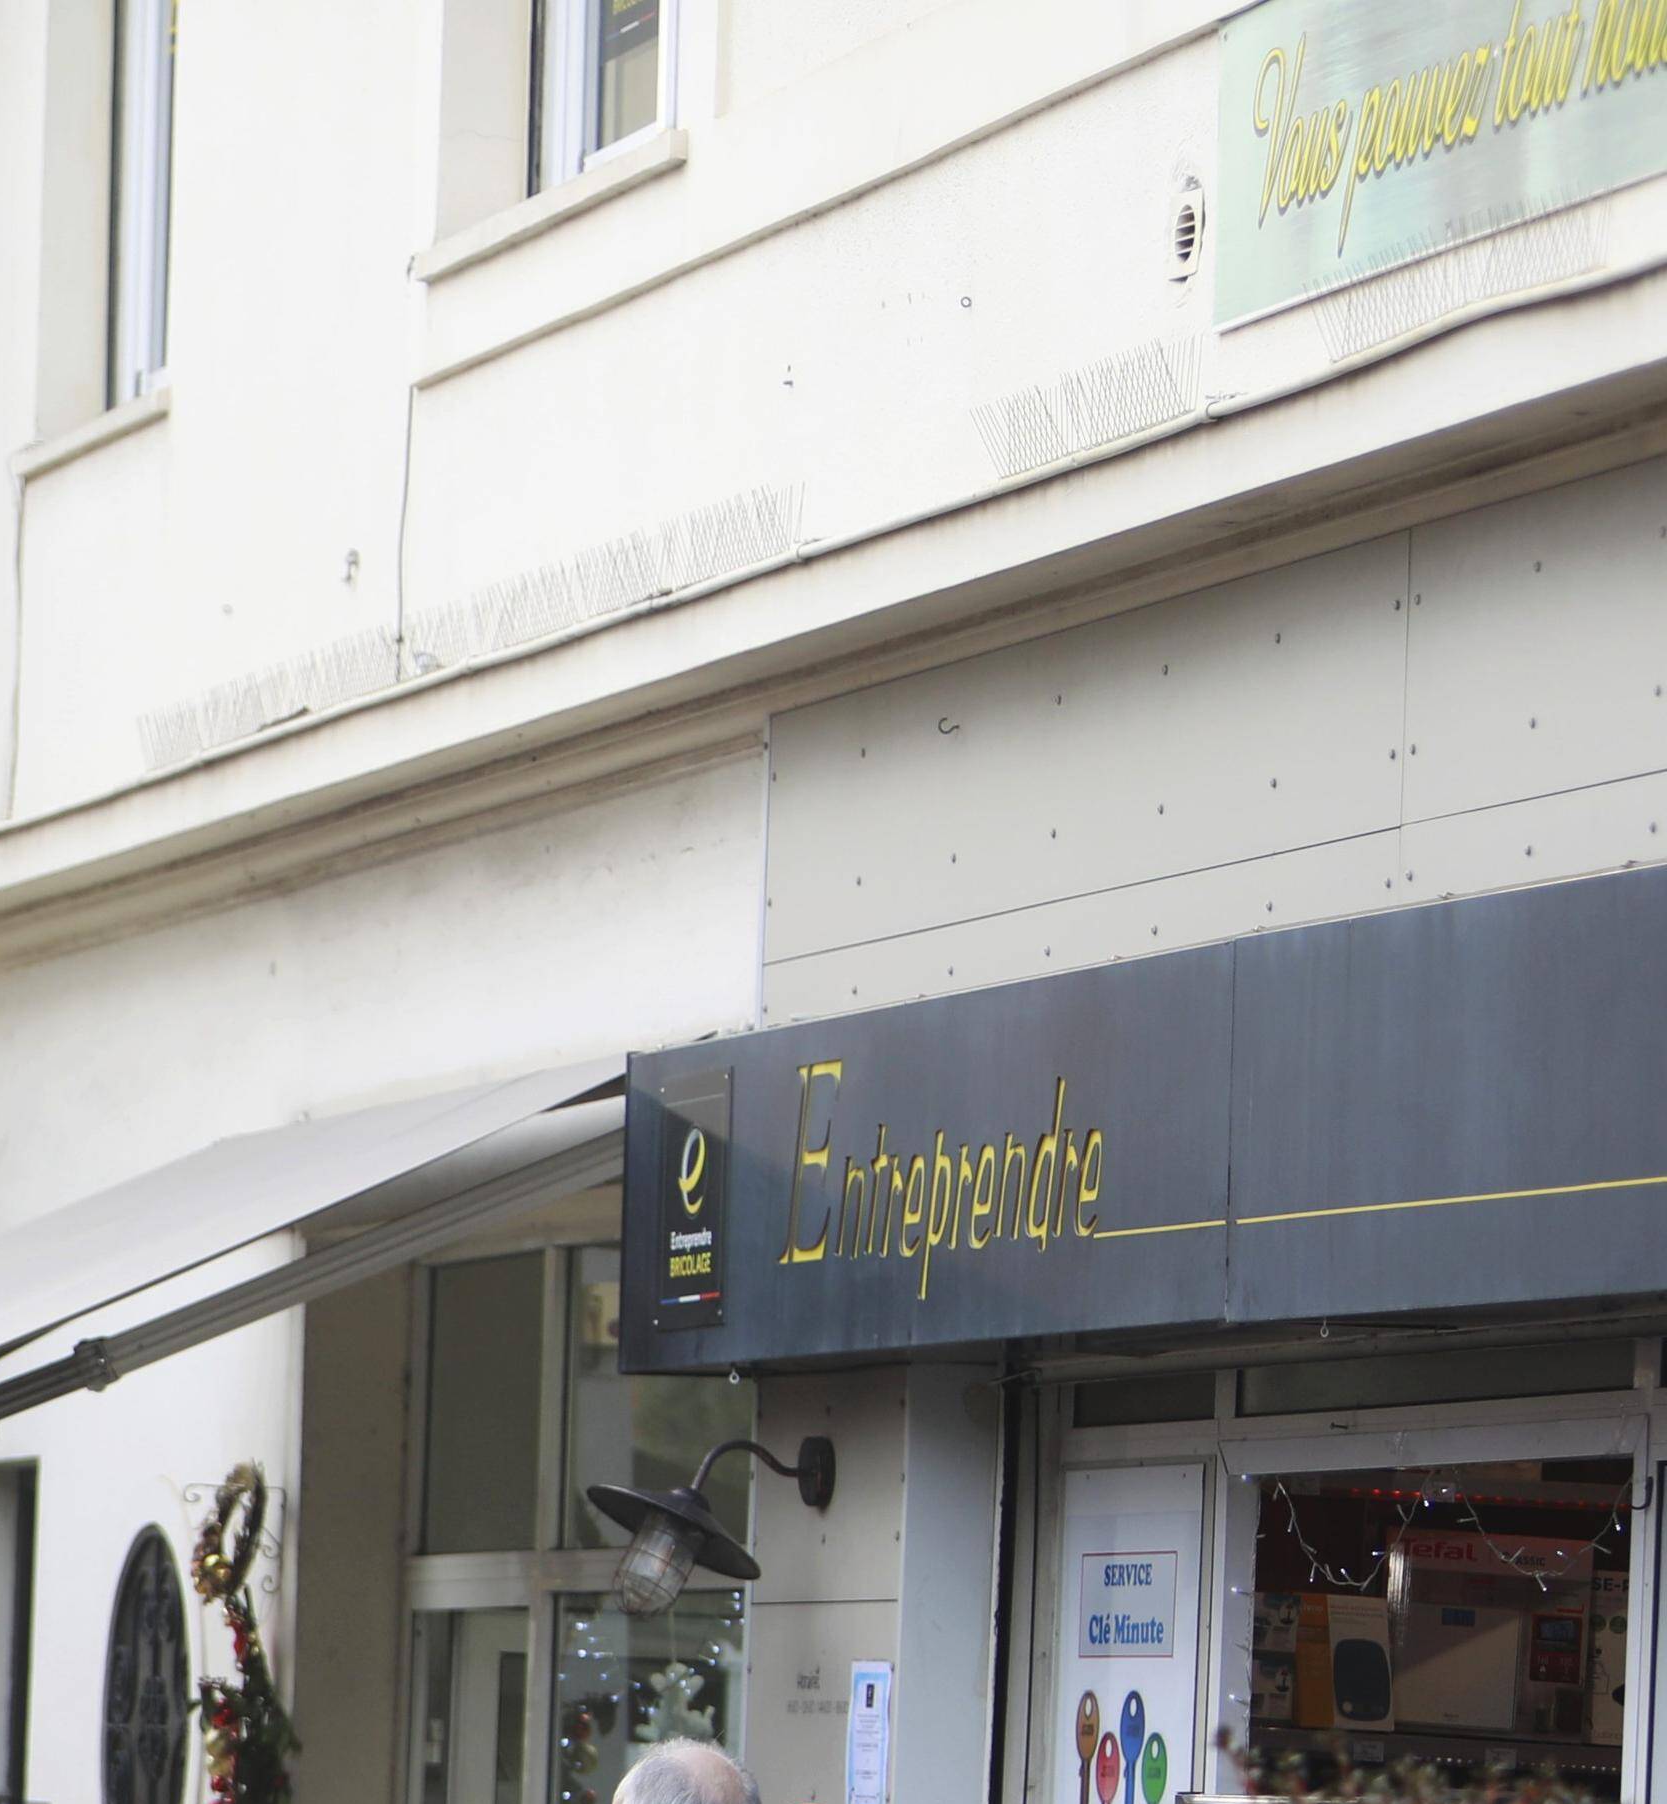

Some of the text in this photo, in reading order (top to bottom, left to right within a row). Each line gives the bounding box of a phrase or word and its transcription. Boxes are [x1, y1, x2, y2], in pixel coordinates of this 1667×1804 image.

[1254, 33, 1345, 229] Vous
[1338, 43, 1492, 258] pouvez
[1494, 0, 1580, 131] tout
[779, 1060, 1103, 1300] Entreprendre
[669, 1228, 713, 1252] Entreprendre
[669, 1252, 712, 1278] BRICOLAGE
[1103, 1563, 1153, 1587] SERVICE
[1088, 1613, 1165, 1645] Clé Minute
